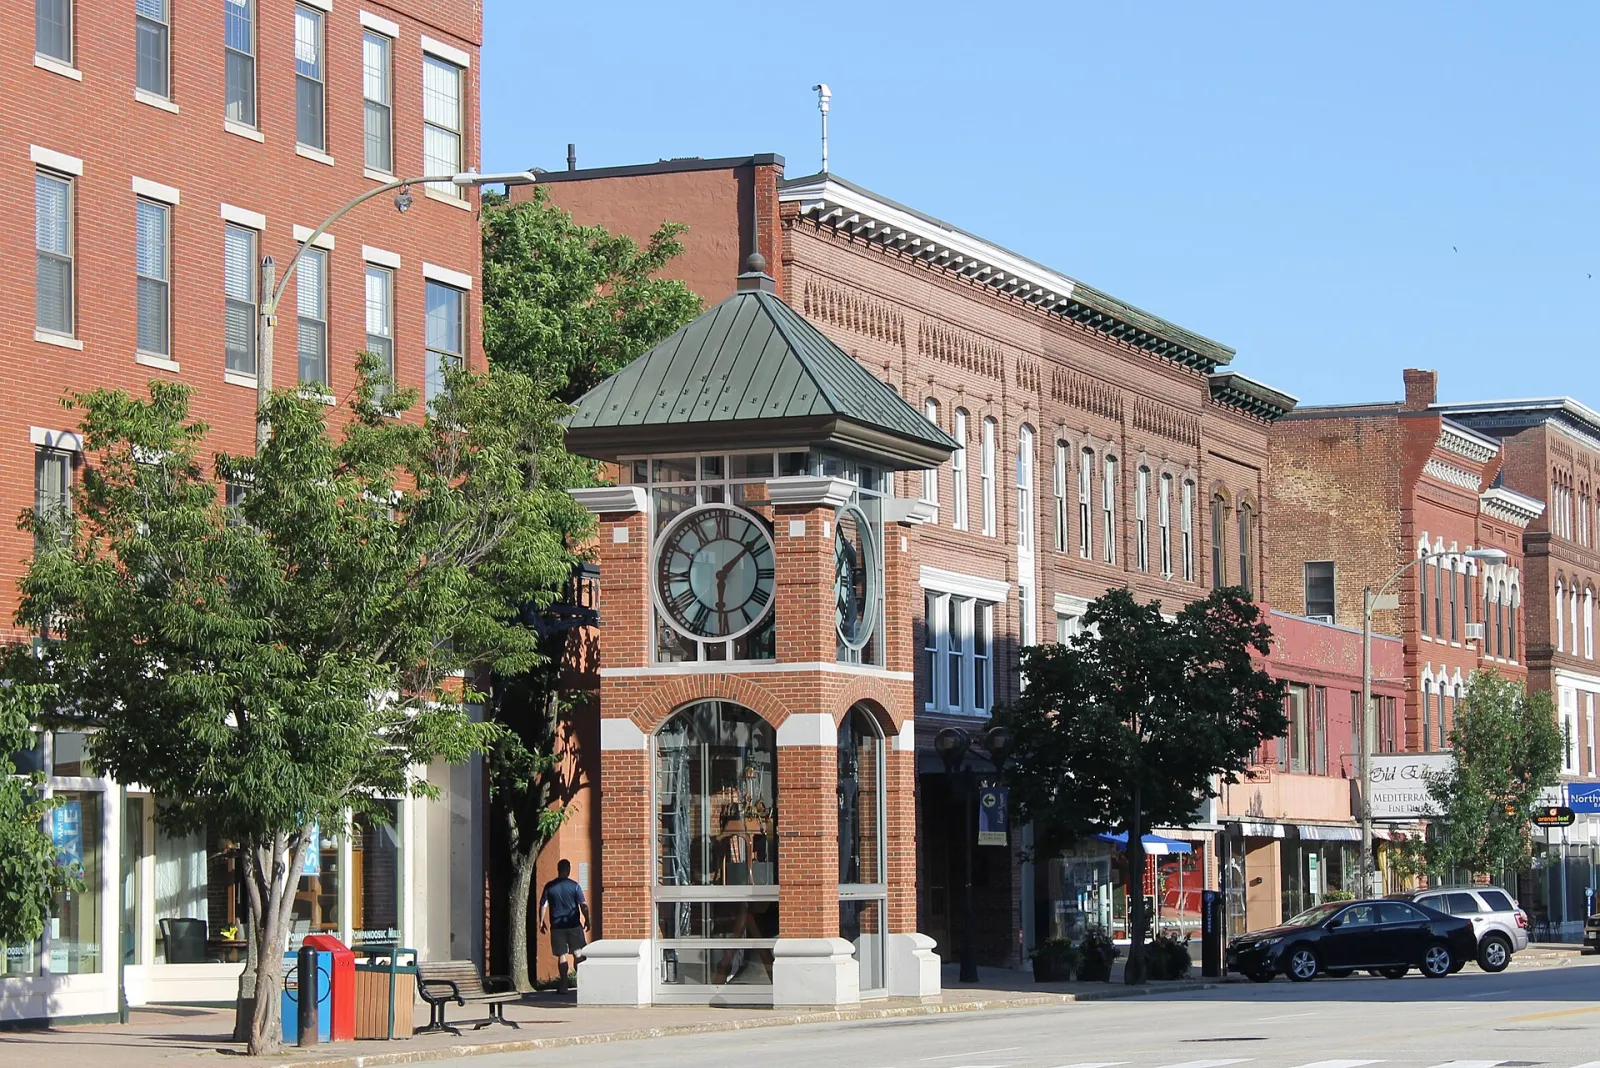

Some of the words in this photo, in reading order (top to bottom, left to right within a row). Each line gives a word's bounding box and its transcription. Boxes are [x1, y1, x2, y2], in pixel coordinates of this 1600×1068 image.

[1370, 766, 1396, 783] Old
[1373, 793, 1434, 803] MEDITERRAN
[1388, 804, 1404, 813] FINE
[352, 930, 387, 940] POMPANOOSUC
[388, 927, 401, 938] MILLS
